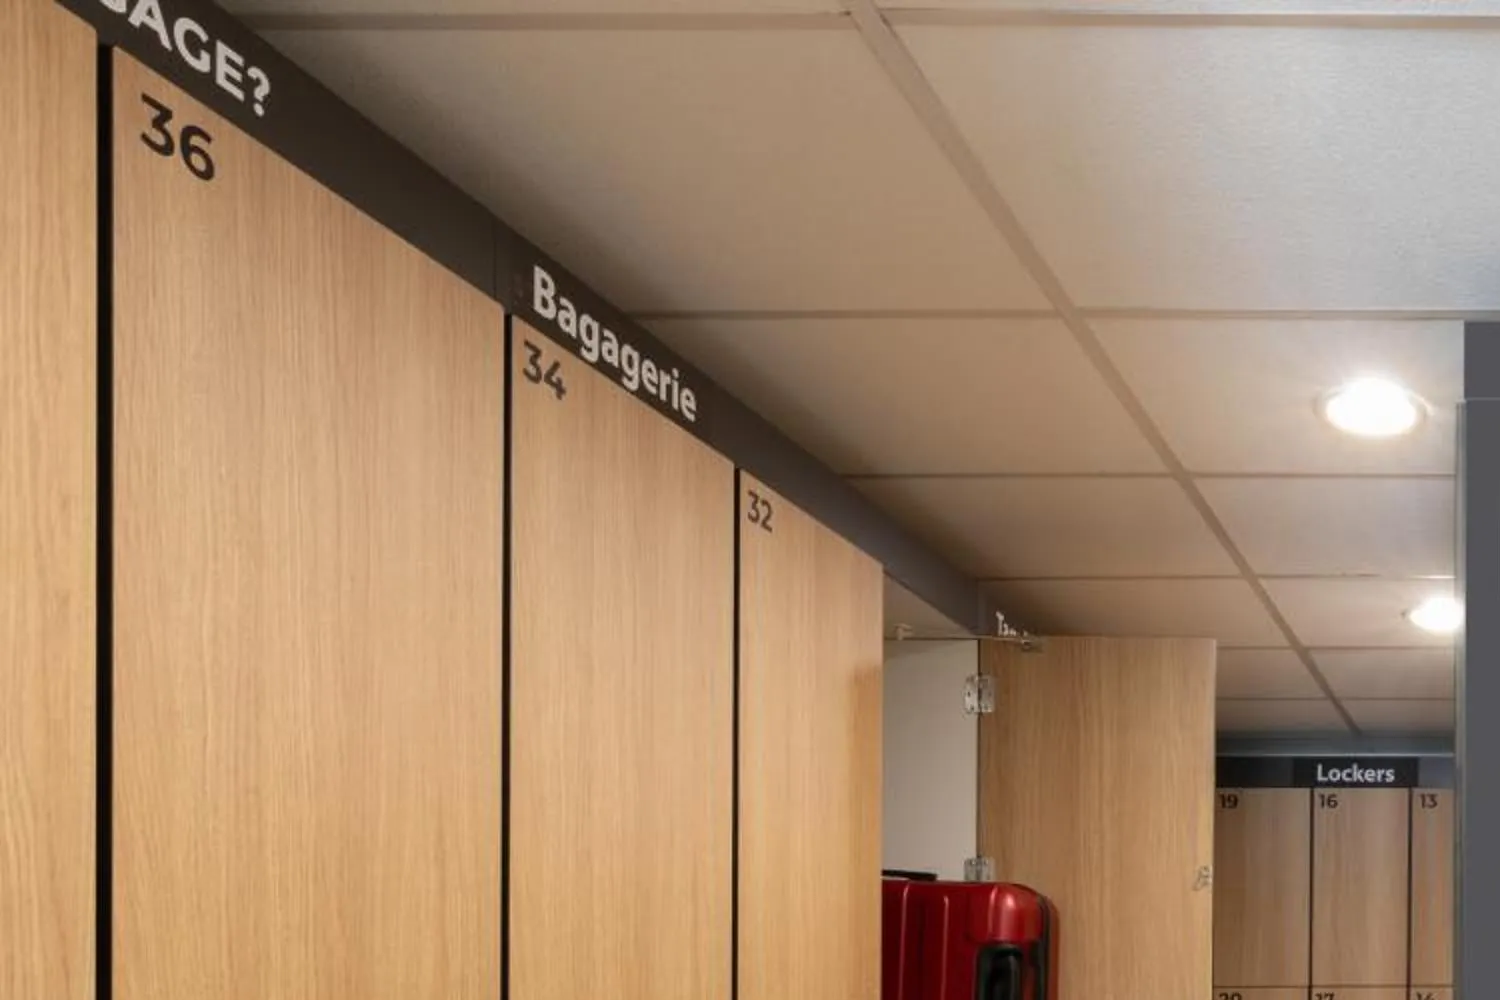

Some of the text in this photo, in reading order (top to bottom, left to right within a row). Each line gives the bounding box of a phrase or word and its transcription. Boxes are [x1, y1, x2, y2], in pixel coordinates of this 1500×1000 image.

[100, 0, 271, 117] AGE?
[140, 92, 215, 182] 36
[532, 265, 697, 422] Bagagerie
[522, 339, 567, 400] 34
[747, 490, 773, 533] 32
[1316, 763, 1396, 783] Lockers
[1219, 793, 1239, 809] 19
[1318, 793, 1338, 809] 16
[1420, 793, 1438, 809] 13
